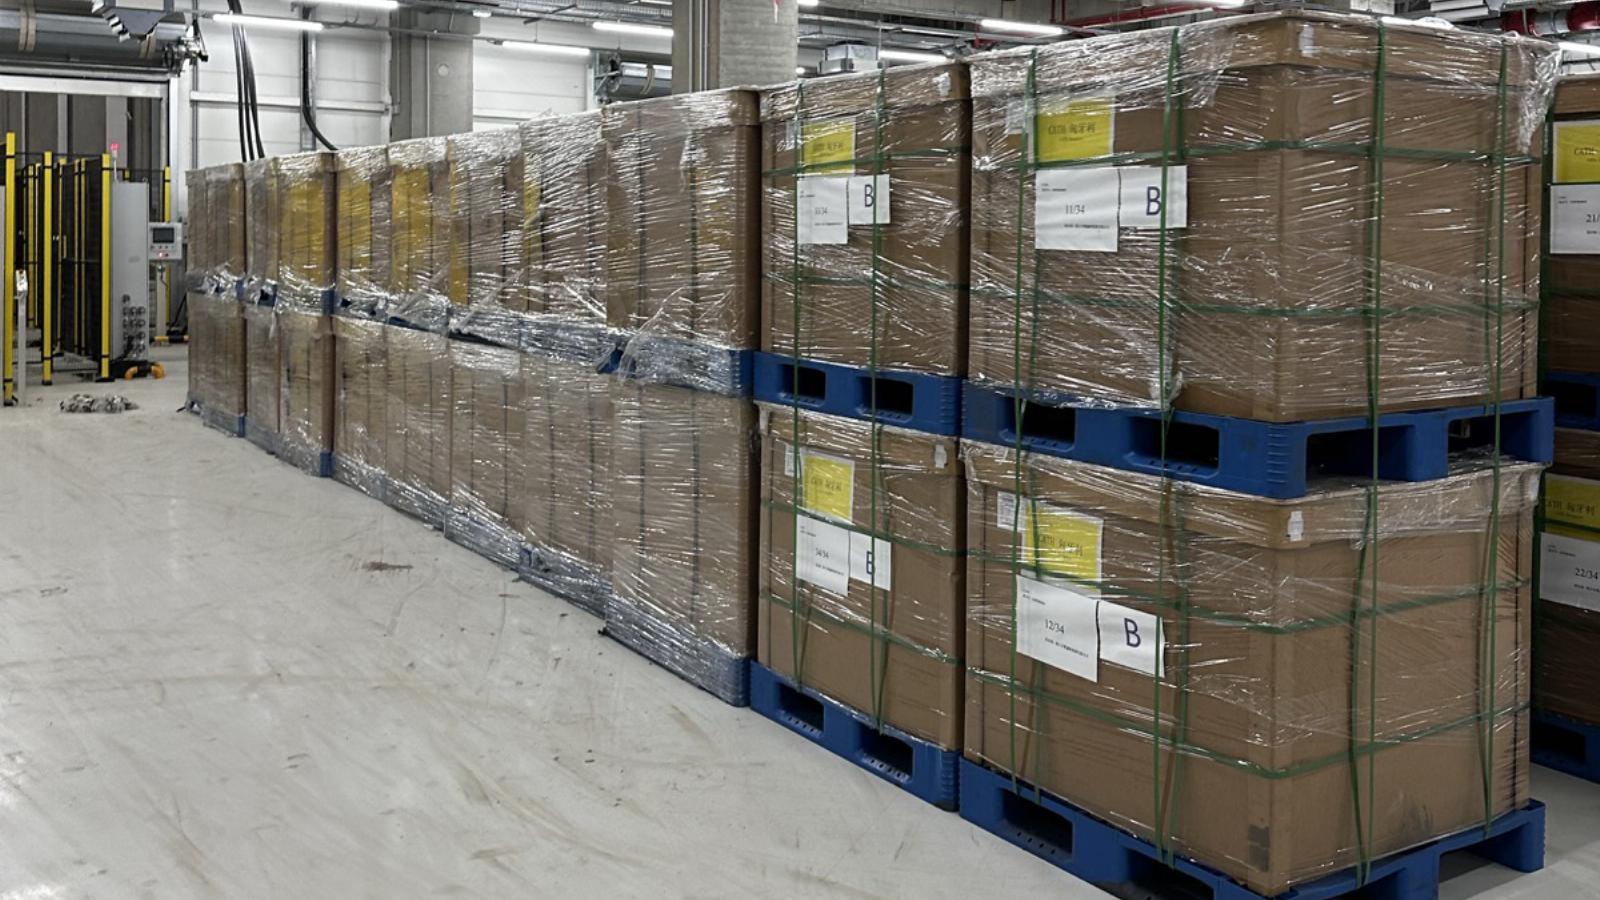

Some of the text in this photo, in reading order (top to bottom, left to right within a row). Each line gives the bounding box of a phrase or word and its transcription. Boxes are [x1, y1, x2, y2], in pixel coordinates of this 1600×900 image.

[865, 184, 876, 208] B
[1146, 186, 1162, 216] B
[1065, 204, 1085, 215] 11/34
[1575, 567, 1598, 580] 22/34
[1044, 618, 1065, 635] 12/34
[1124, 617, 1141, 648] B
